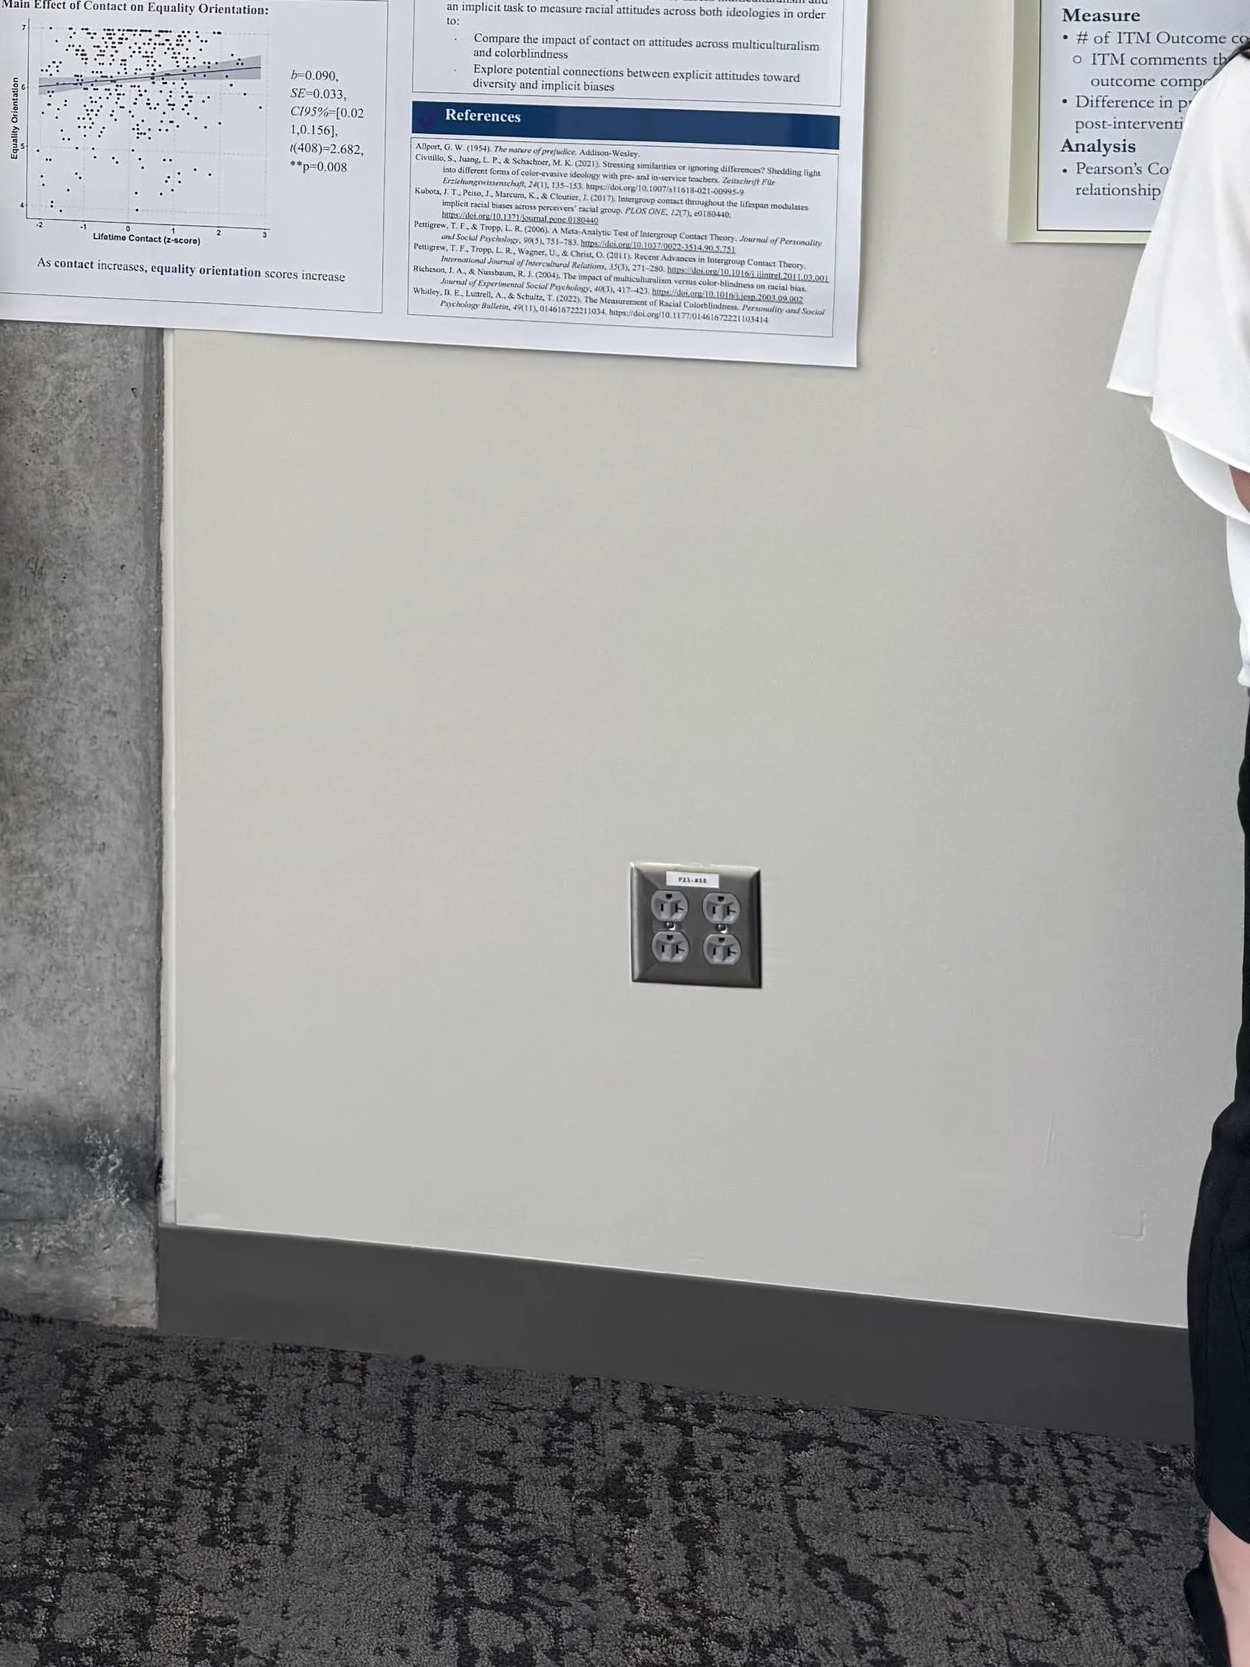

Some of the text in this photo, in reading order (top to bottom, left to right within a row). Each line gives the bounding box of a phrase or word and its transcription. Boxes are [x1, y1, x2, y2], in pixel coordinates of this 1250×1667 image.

[69, 0, 81, 10] of
[83, 0, 127, 11] Contact
[130, 4, 144, 12] on
[147, 1, 195, 16] Equality
[198, 3, 268, 15] Orientation:
[1061, 7, 1140, 22] Measure
[290, 69, 339, 82] b=0.090,
[289, 87, 347, 101] SE=0.033,
[445, 108, 521, 123] References
[291, 124, 338, 138] 1,0.156],
[289, 142, 364, 156] t(408)=2.682,
[1059, 138, 1136, 157] Analysis
[37, 257, 345, 282] As contact increases, equality orientation scores increase
